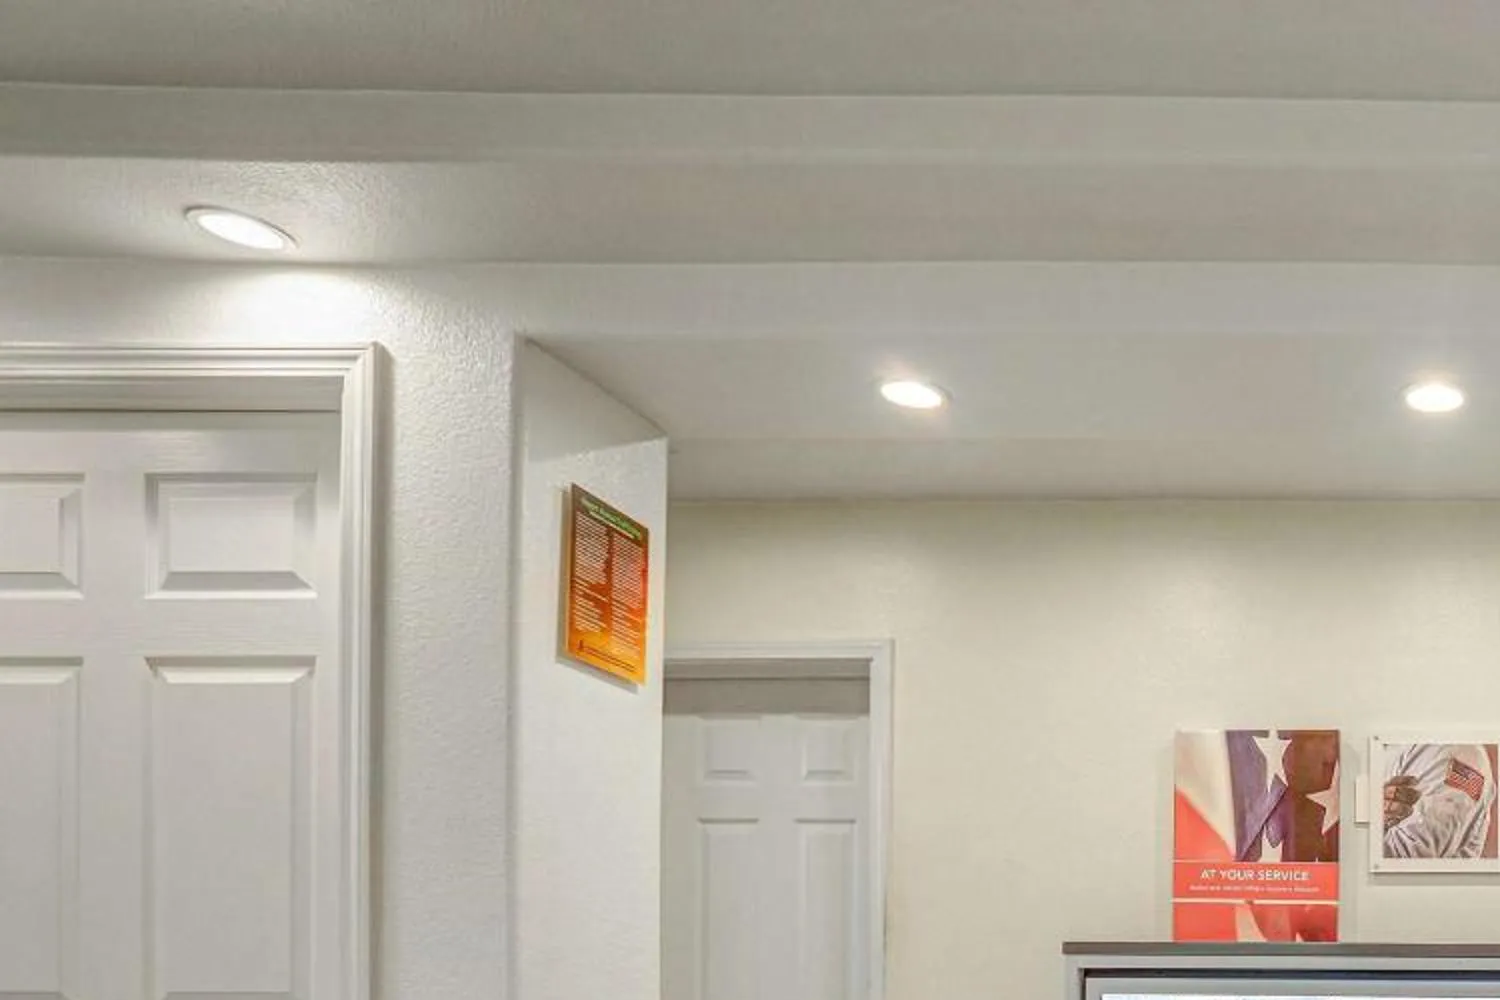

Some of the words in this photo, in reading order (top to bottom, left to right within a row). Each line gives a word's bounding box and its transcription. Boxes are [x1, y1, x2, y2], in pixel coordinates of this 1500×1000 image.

[1201, 869, 1217, 879] AT
[1220, 869, 1254, 880] YOUR
[1257, 869, 1310, 881] SERVICE
